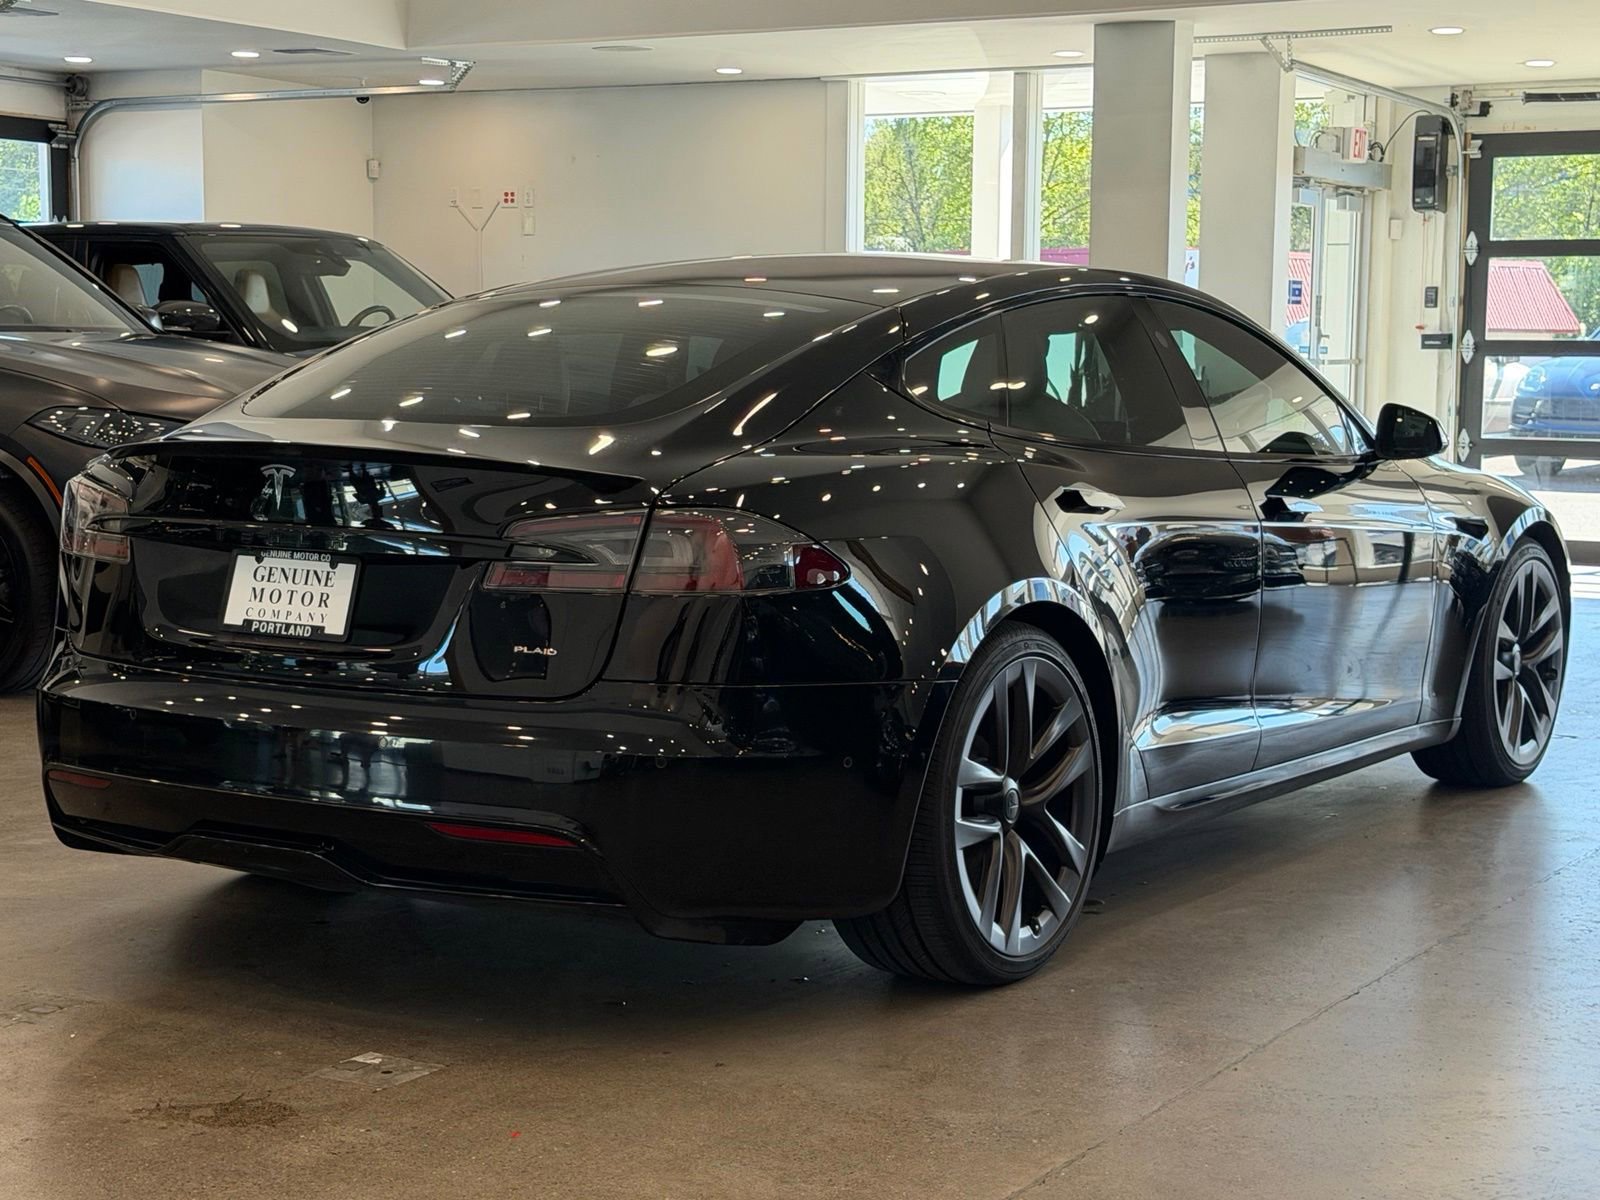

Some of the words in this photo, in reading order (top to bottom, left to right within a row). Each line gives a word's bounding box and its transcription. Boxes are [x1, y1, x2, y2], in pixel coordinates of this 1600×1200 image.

[293, 552, 319, 561] MOTOR
[321, 554, 331, 562] CO
[254, 566, 335, 587] GENUINE
[249, 587, 330, 608] MOTOR
[246, 607, 327, 623] COMPANY
[251, 621, 312, 637] PORTLAND
[513, 645, 558, 656] PLAID
